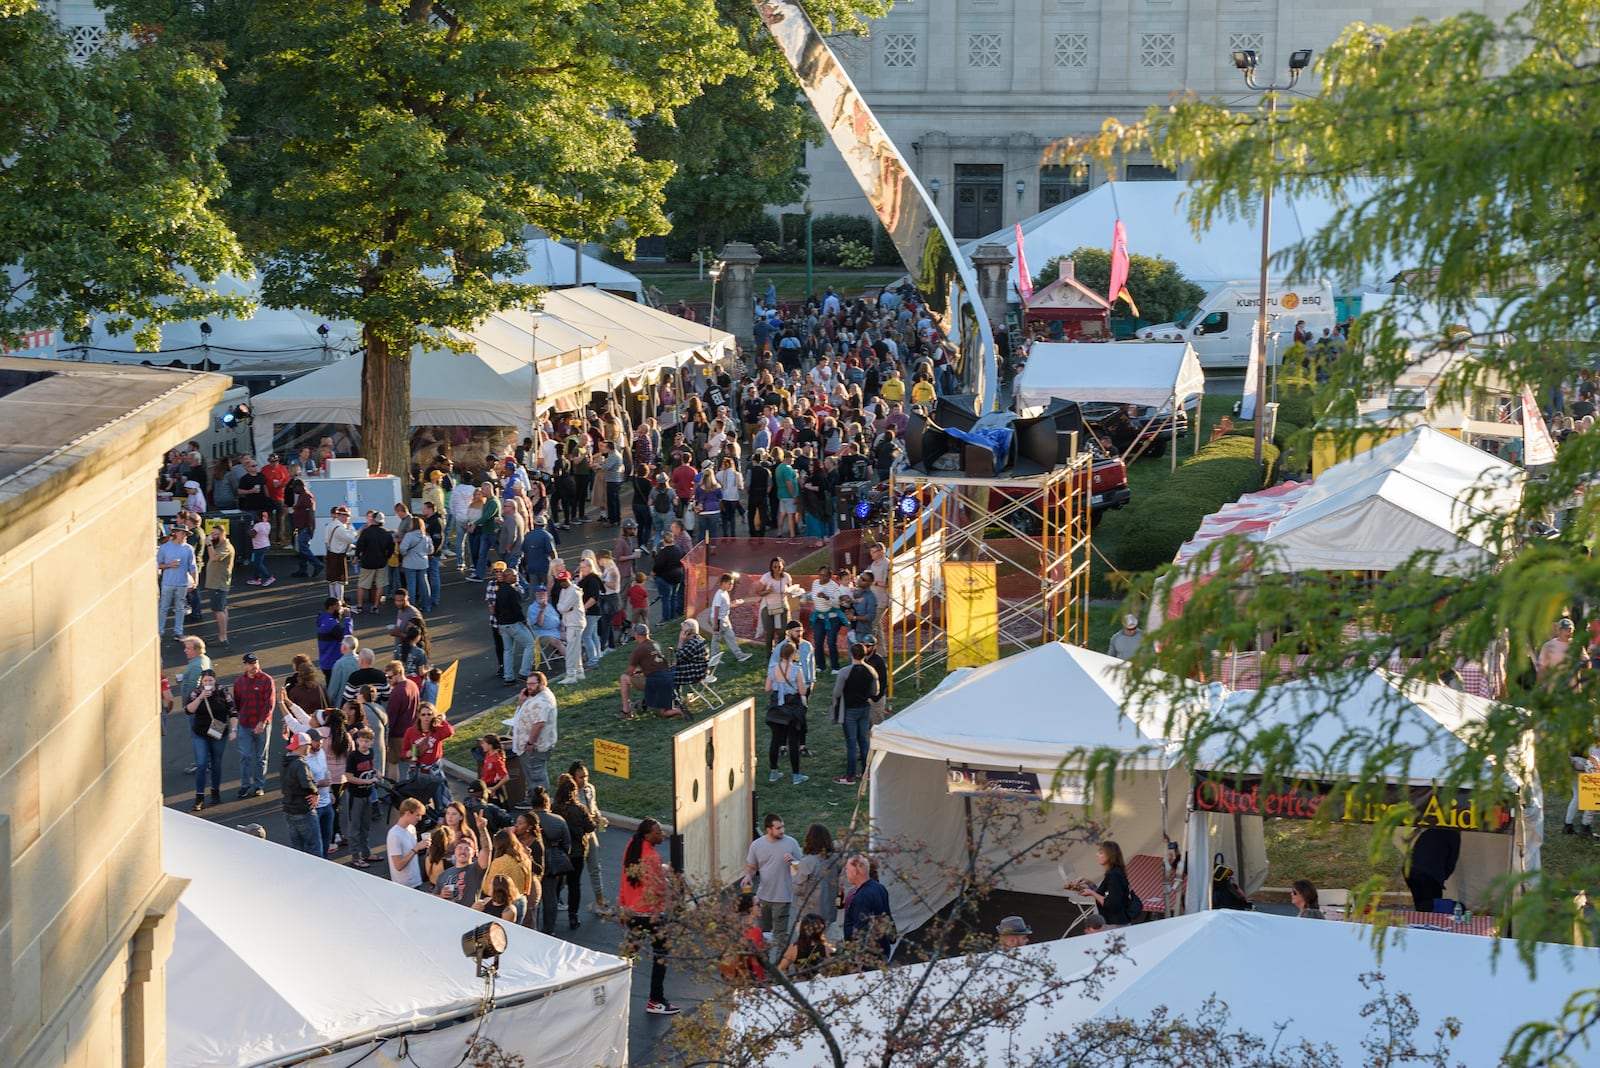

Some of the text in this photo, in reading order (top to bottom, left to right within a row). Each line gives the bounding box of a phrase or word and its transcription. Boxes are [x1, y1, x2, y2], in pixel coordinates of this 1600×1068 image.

[1302, 296, 1321, 305] BBQ
[1196, 780, 1478, 829] Oktoberfes Fir Aid
